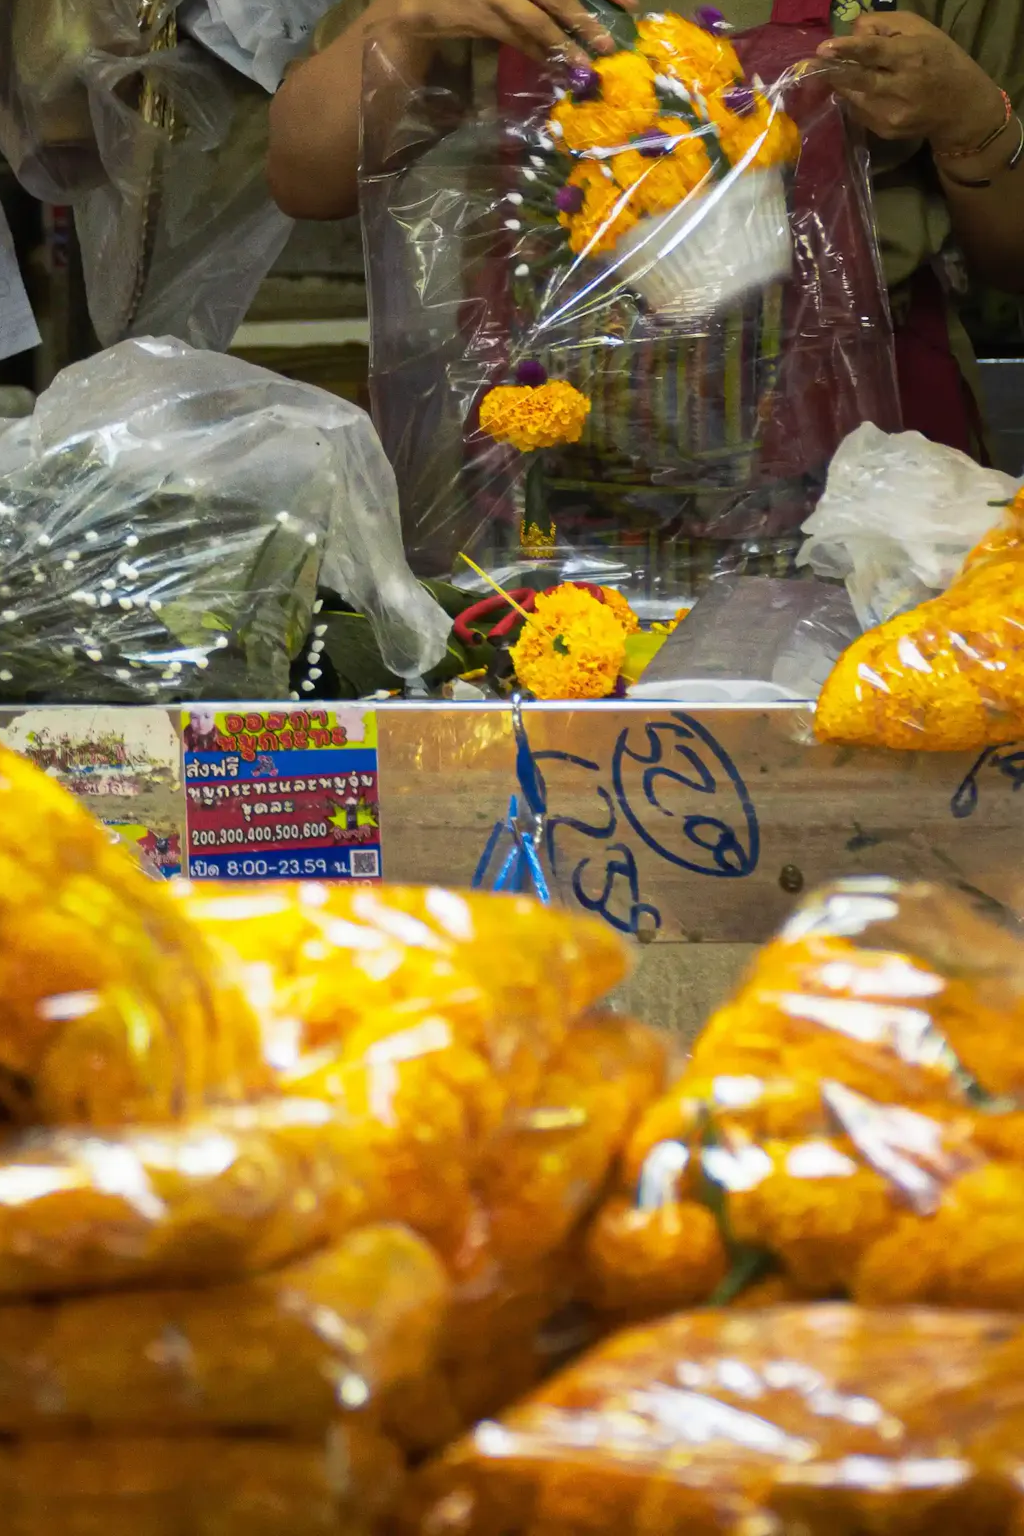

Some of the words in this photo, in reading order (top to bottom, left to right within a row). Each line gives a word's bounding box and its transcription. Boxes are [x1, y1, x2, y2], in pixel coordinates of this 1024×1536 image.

[217, 727, 347, 762] หมูกระทะ
[186, 756, 239, 778] ส่งฟรี
[192, 822, 327, 846] 200,300,400,500,600
[190, 859, 220, 877] เปิด
[227, 858, 327, 876] 8:00-23.59
